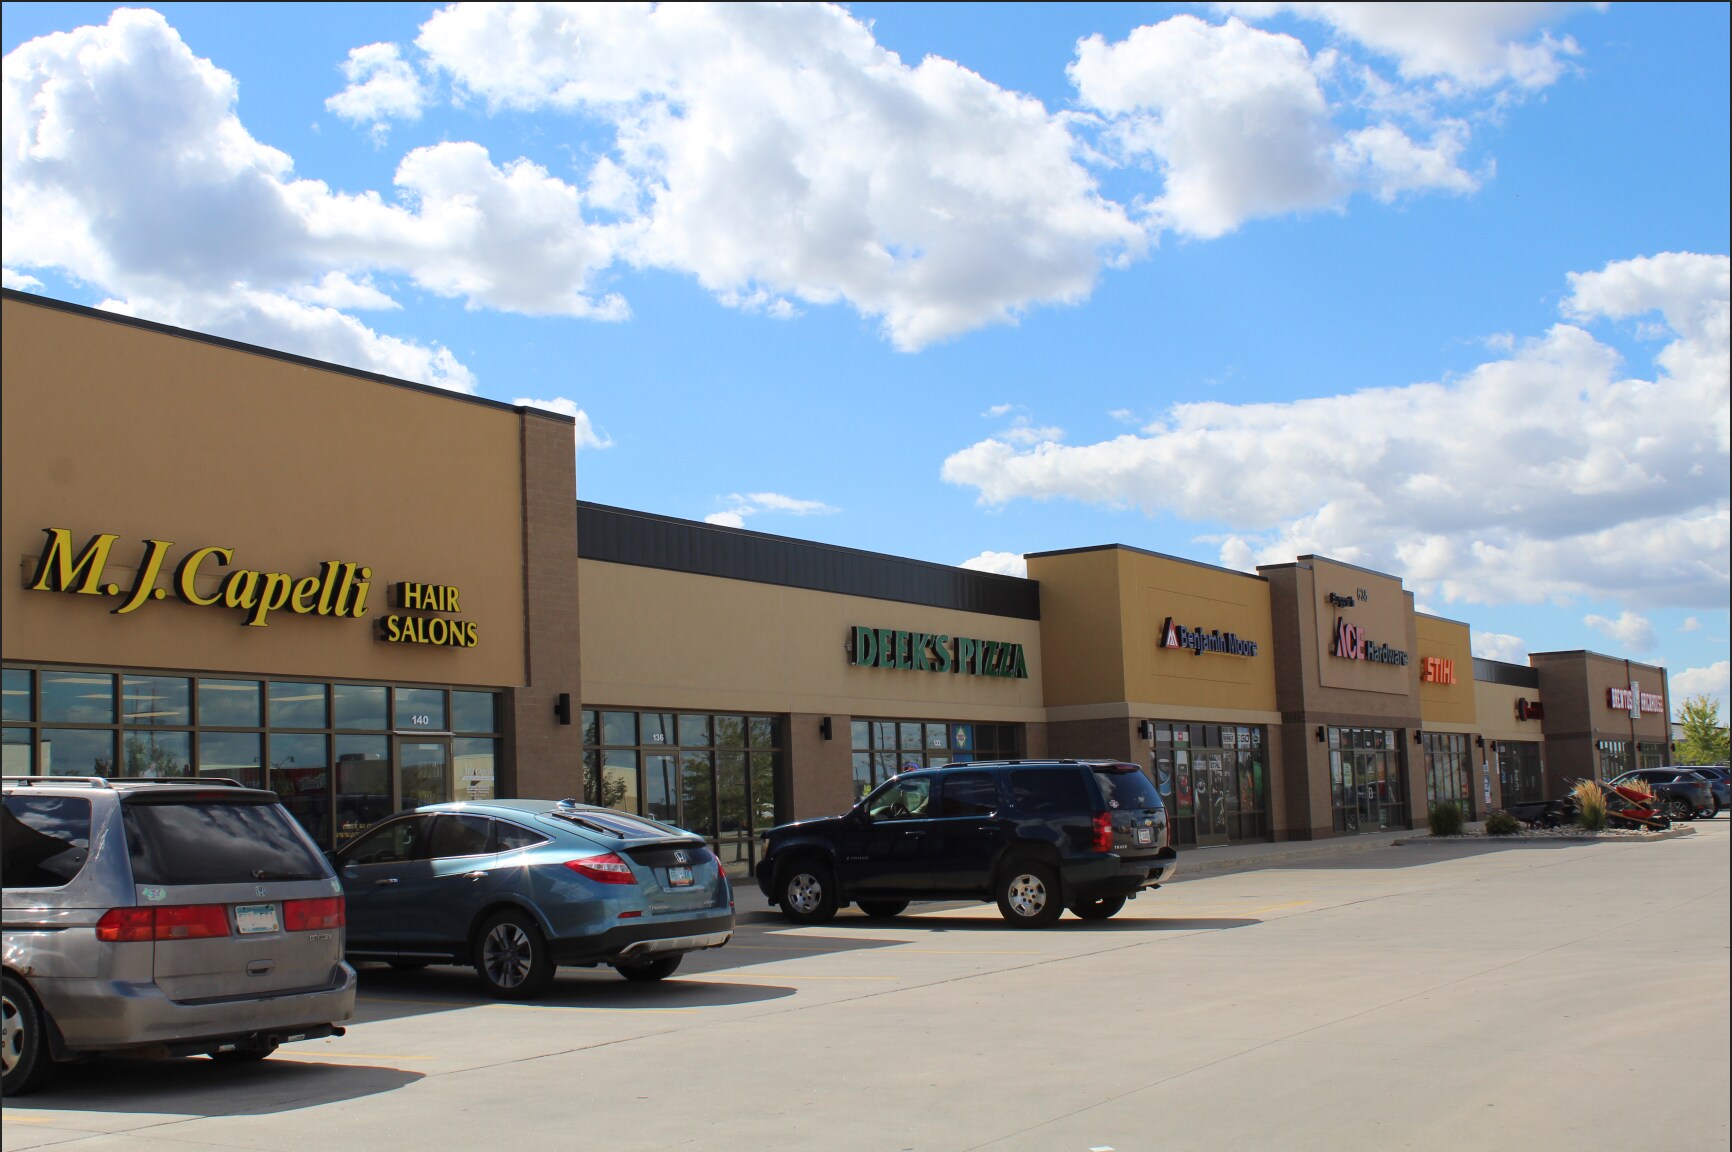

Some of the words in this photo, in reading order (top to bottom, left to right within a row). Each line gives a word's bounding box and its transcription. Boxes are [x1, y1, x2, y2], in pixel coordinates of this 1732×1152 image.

[174, 546, 372, 627] Capelli
[398, 582, 460, 613] HAIR
[385, 615, 478, 648] SALONS
[1177, 625, 1227, 655] Benjamin
[1226, 633, 1258, 656] Moore
[1336, 616, 1366, 660] ACE
[1366, 641, 1408, 666] Hardware
[852, 626, 951, 673] DEEK'S
[954, 637, 1029, 679] PIZZA
[1424, 657, 1457, 684] STIHL
[411, 714, 429, 726] 140
[653, 733, 664, 742] 136
